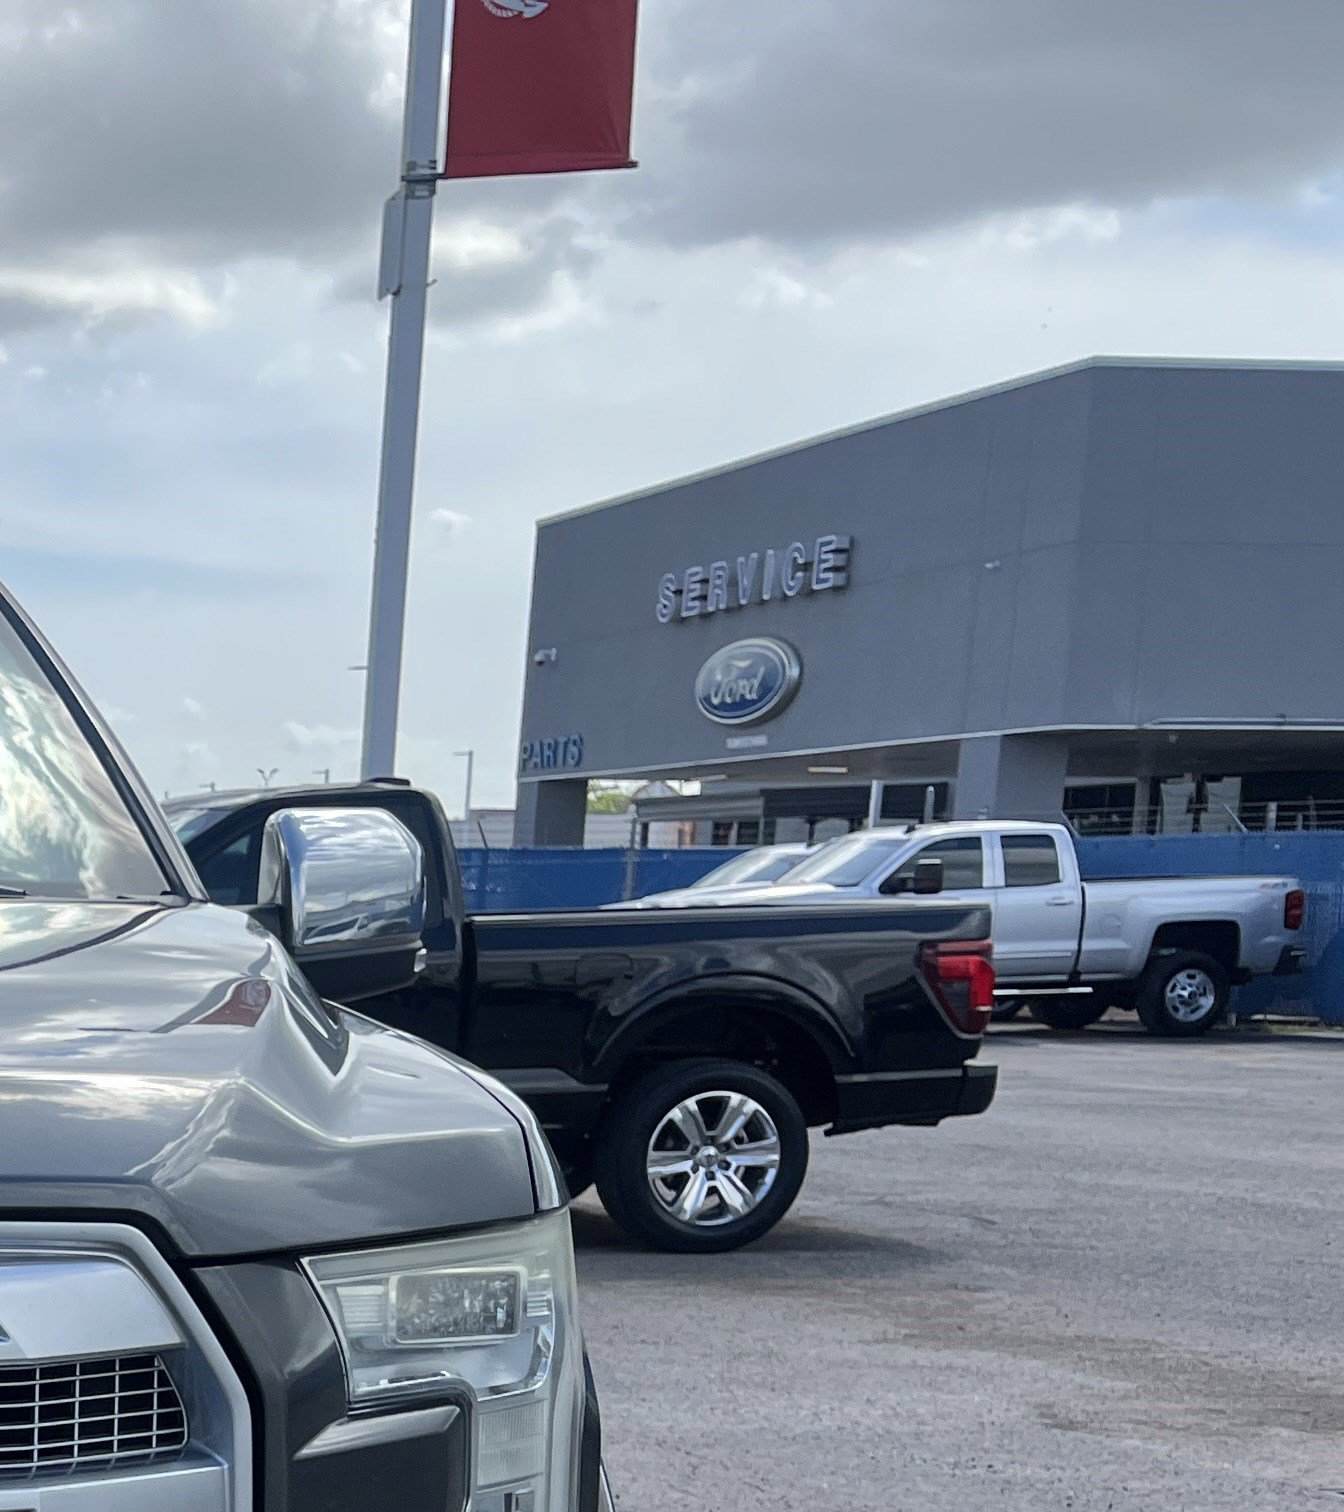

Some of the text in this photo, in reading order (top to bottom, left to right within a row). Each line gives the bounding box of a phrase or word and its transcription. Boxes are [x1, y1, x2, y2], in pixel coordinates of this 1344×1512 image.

[655, 533, 852, 624] SERVICE
[711, 658, 765, 707] Ford
[520, 733, 584, 772] PARTS
